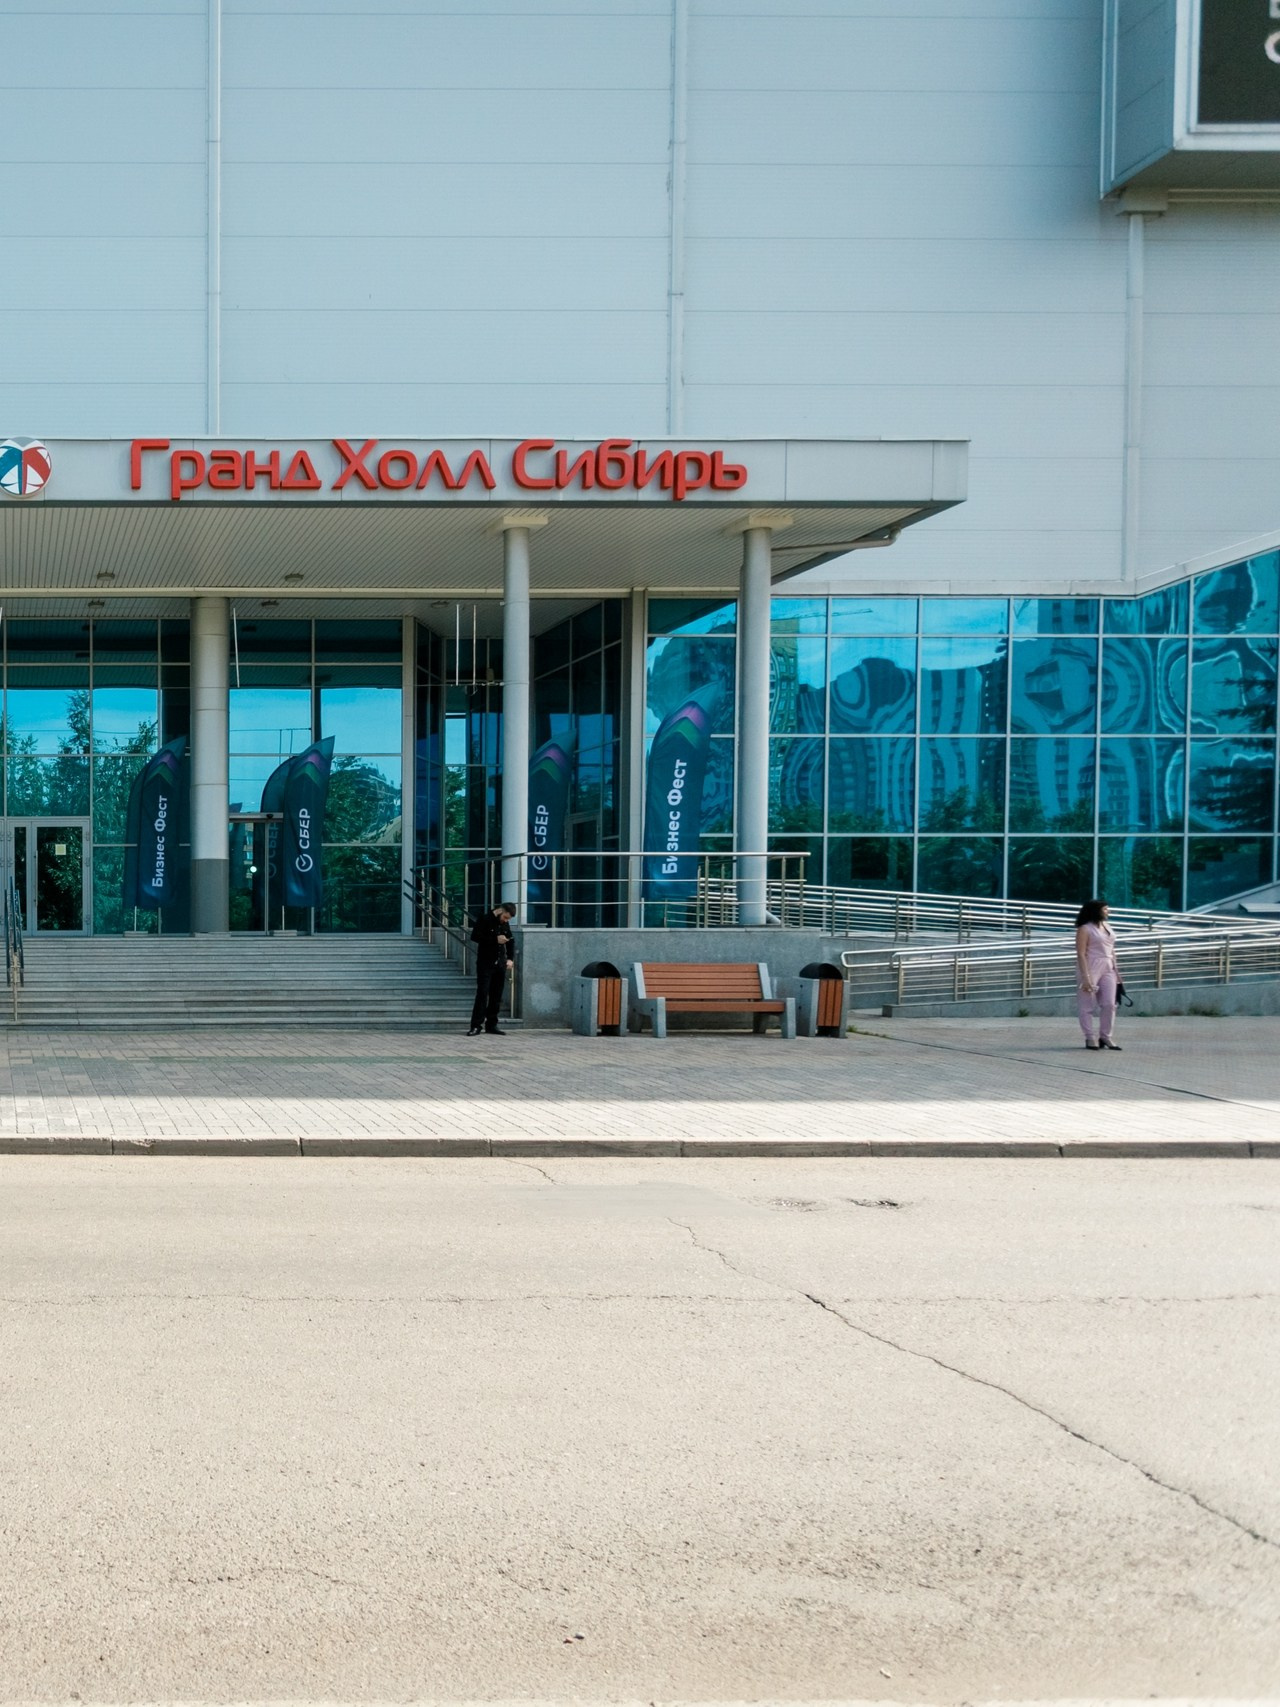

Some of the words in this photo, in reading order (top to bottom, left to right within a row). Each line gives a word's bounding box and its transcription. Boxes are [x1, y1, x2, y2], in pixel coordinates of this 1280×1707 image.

[130, 439, 322, 500] Гранд
[331, 439, 496, 490] Холл
[512, 439, 748, 500] Сибирь
[667, 759, 687, 806] Фест
[154, 794, 168, 832] Фест
[298, 808, 311, 849] СБЕР
[534, 804, 549, 847] СБЕР
[151, 835, 165, 887] Бизнес
[661, 810, 681, 874] Бизнес
